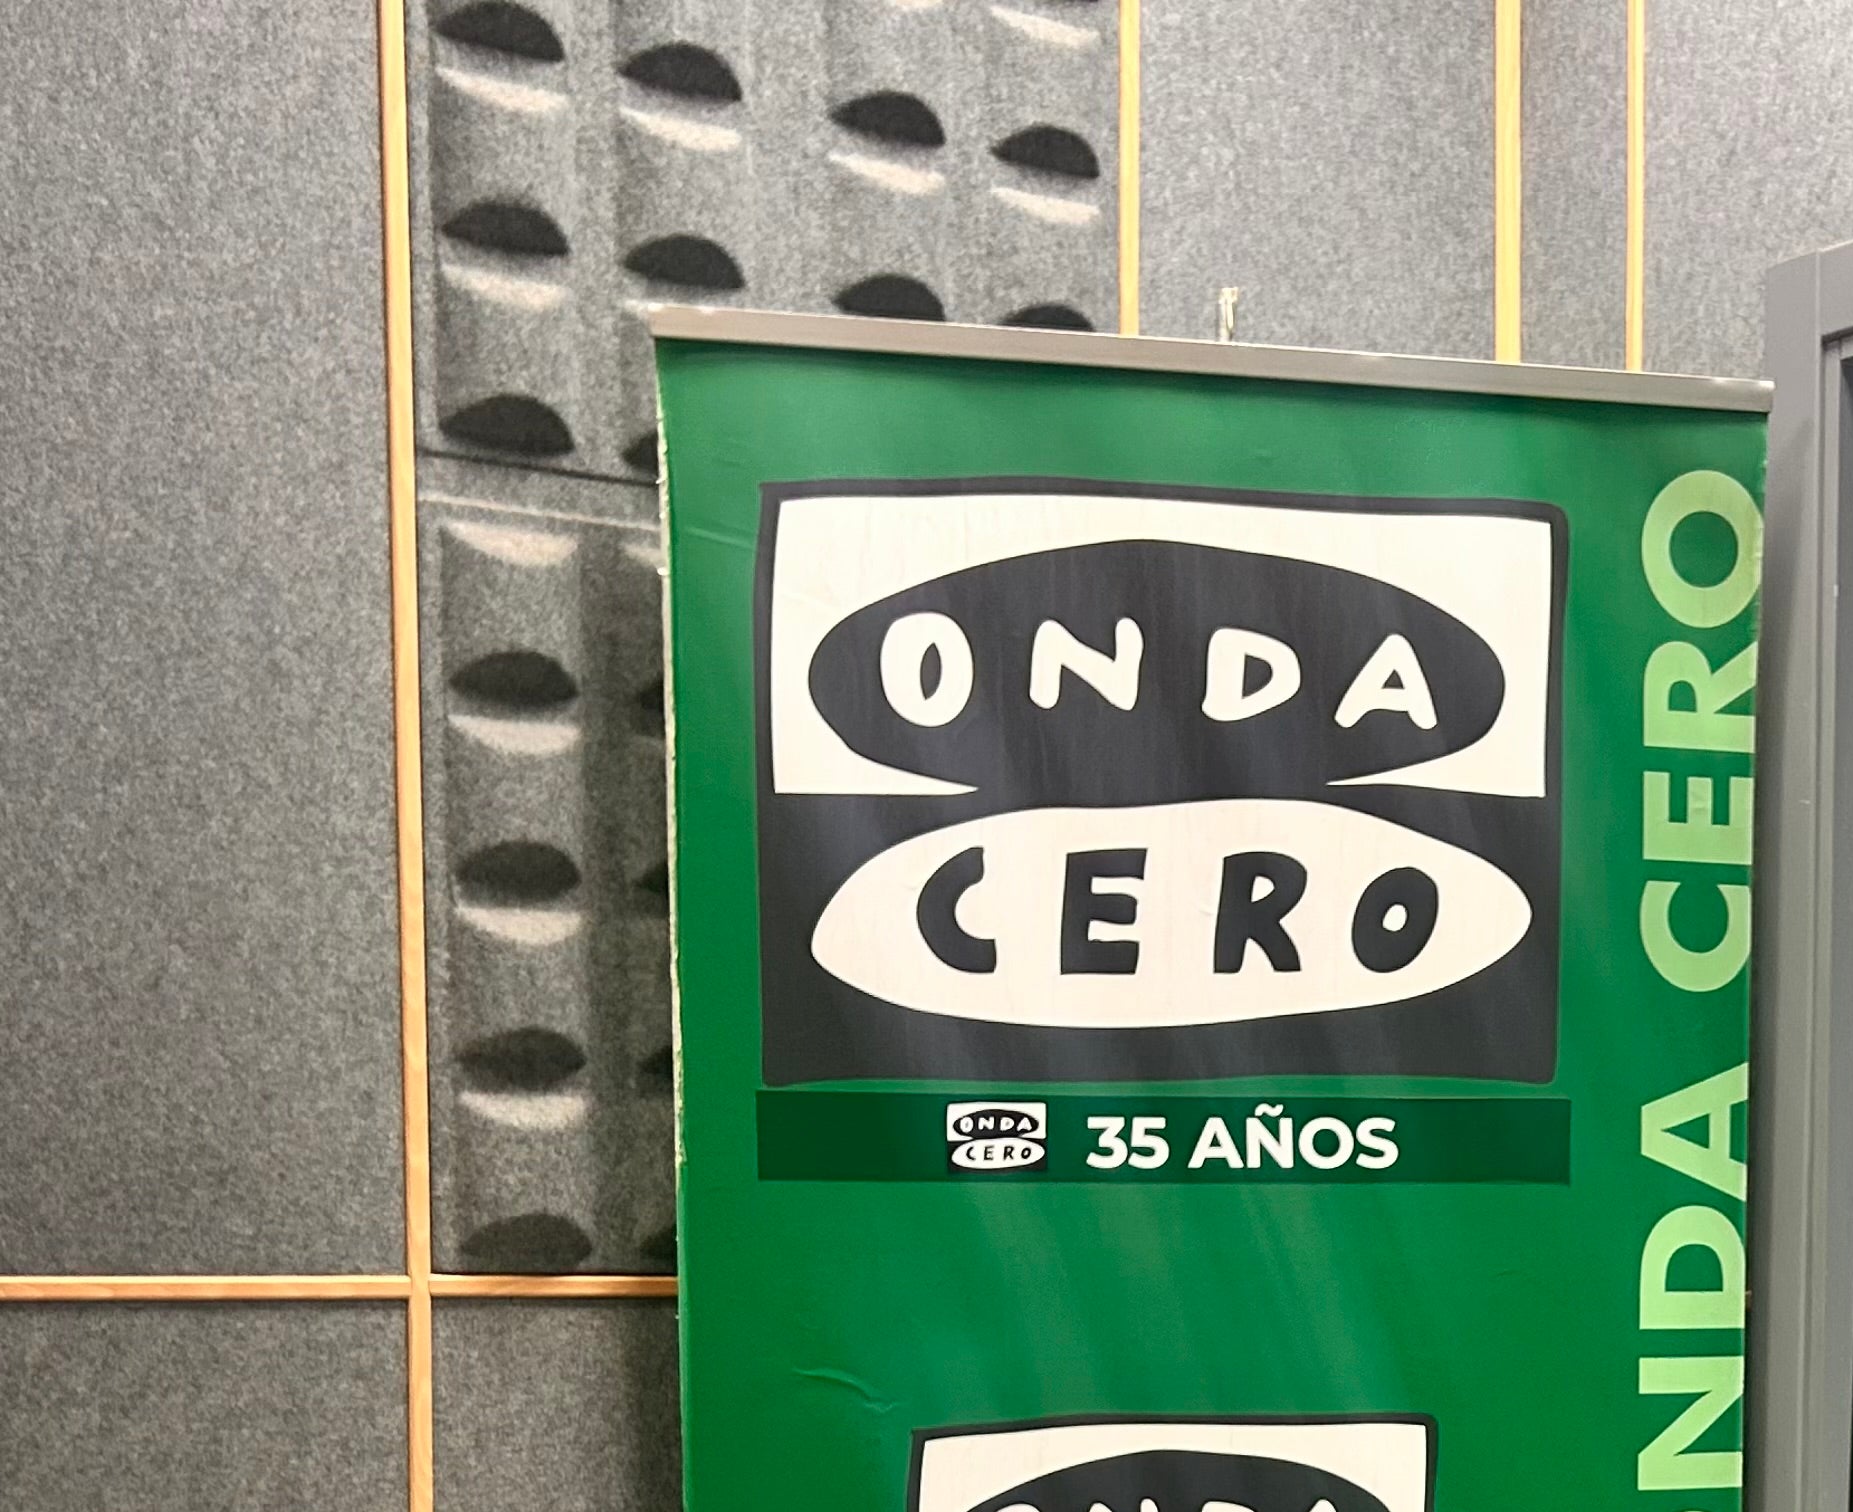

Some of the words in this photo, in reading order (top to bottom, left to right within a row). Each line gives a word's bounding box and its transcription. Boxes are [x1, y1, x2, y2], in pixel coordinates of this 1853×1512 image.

[880, 610, 1438, 730] ONDA
[1640, 469, 1764, 993] CERO
[916, 846, 1439, 975] CERO
[960, 1115, 1033, 1133] ONDA
[965, 1144, 1033, 1162] CERO
[1085, 1116, 1170, 1169] 35
[1187, 1103, 1399, 1170] AÑOS
